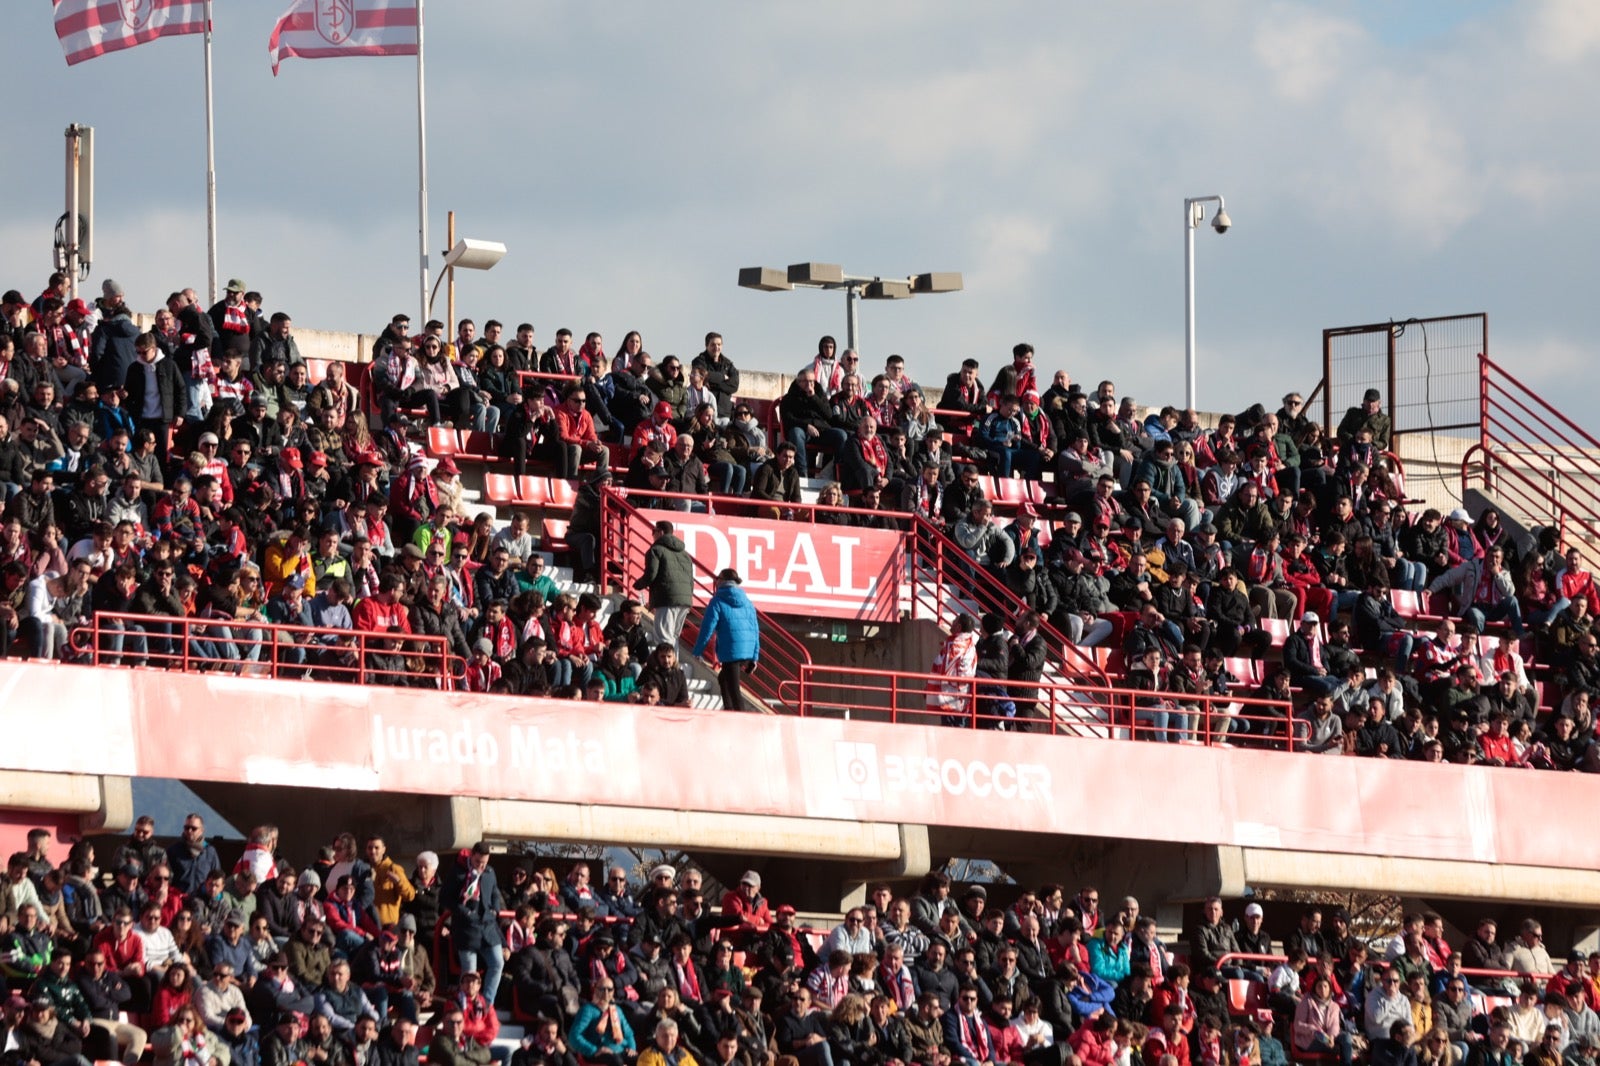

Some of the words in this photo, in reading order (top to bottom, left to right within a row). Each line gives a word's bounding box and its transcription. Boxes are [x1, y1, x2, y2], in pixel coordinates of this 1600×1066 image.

[649, 520, 877, 597] DEAL
[373, 714, 499, 768] Jurado
[510, 724, 605, 774] Mata
[884, 754, 1052, 801] BESOCCER
